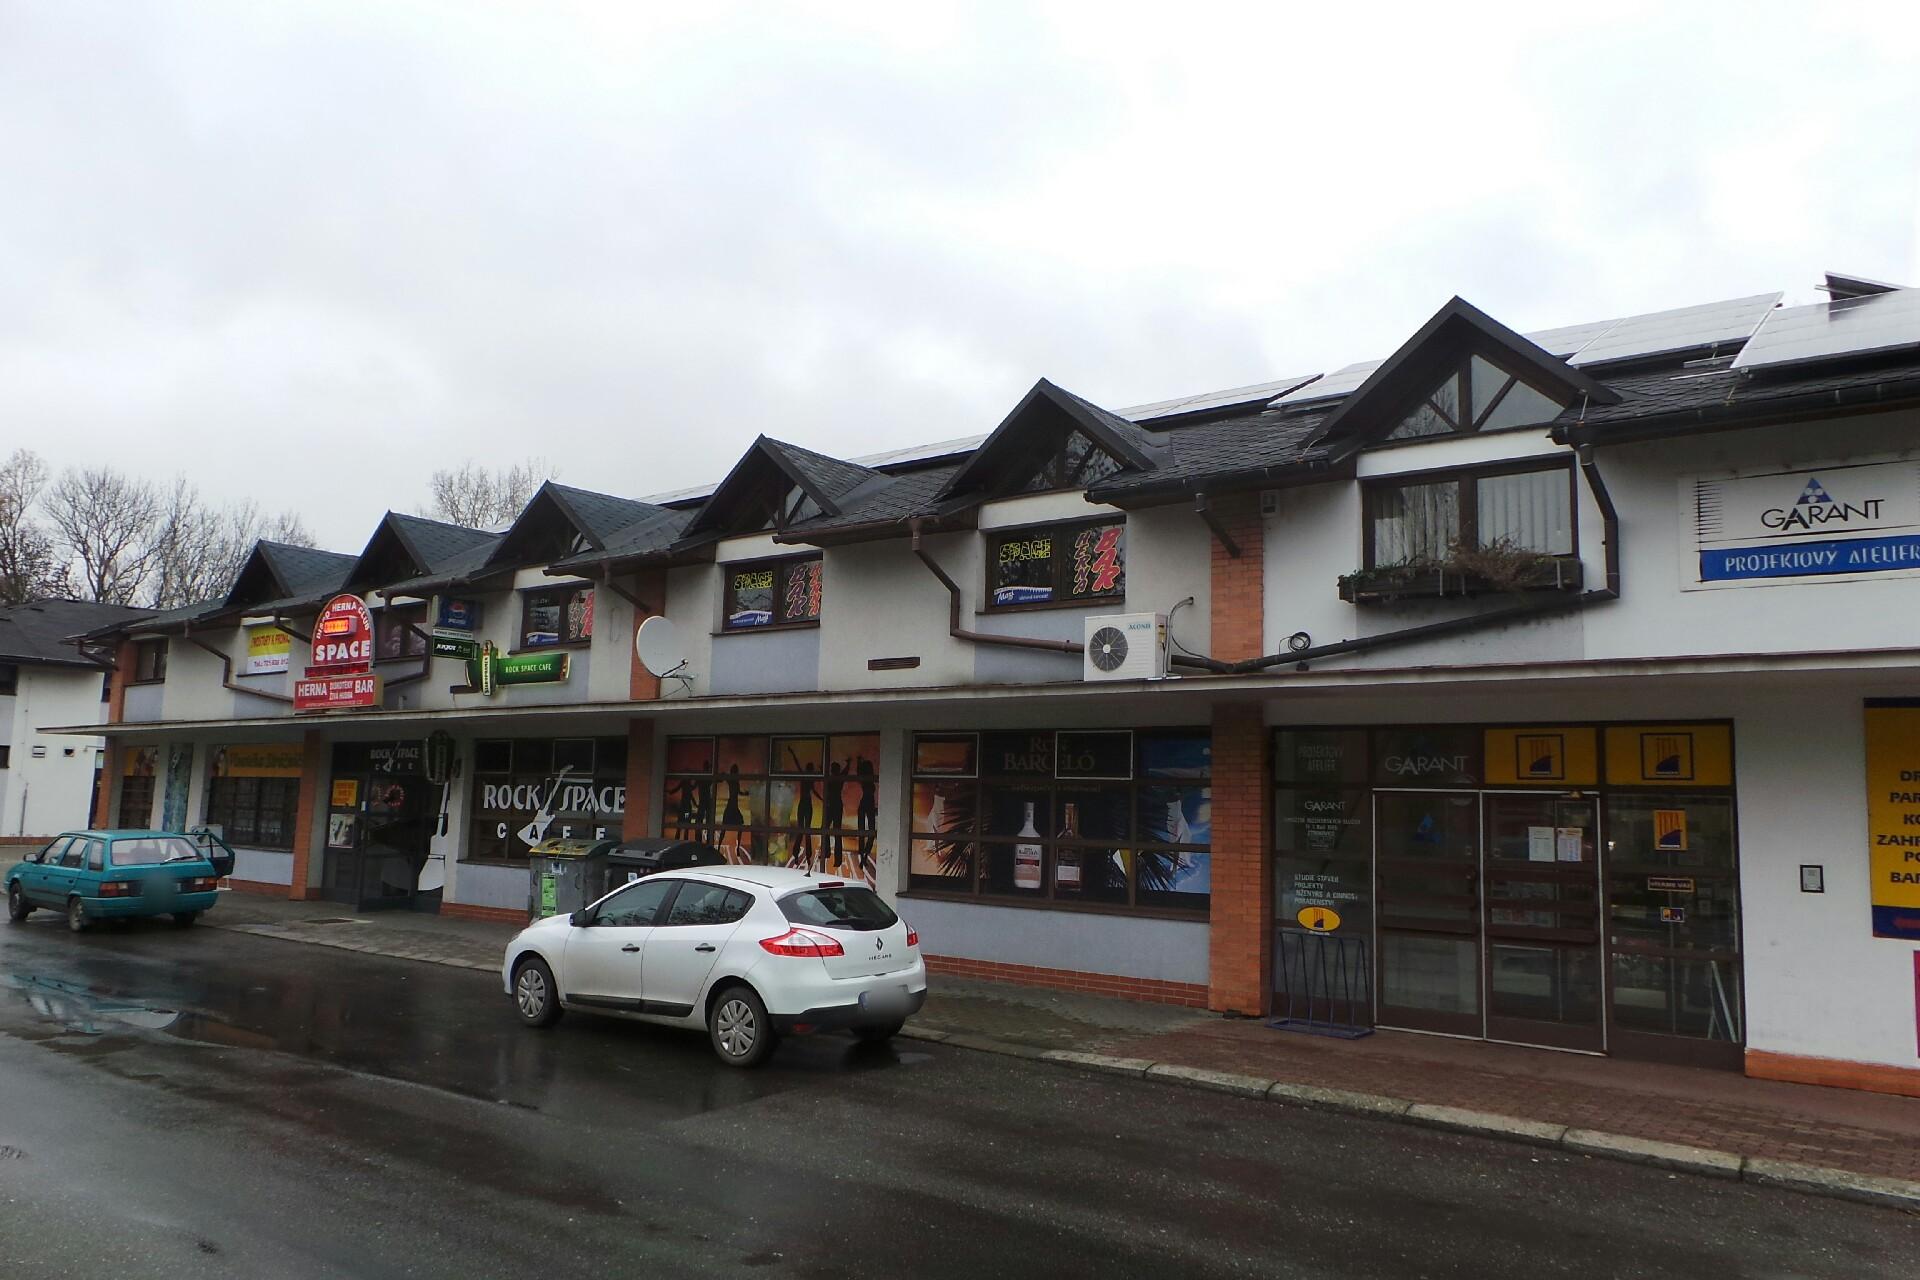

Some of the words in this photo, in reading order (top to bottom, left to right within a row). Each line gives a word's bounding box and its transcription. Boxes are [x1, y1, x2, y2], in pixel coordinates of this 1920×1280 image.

[1761, 498, 1885, 531] GARANT
[999, 539, 1051, 563] SPACE
[1092, 527, 1123, 592] BAR
[332, 601, 357, 613] HERNA
[314, 639, 371, 662] SPACE
[298, 682, 328, 697] HERNA
[354, 679, 374, 694] BAR
[1384, 755, 1469, 776] GARANT
[483, 784, 541, 811] ROCK
[559, 785, 625, 813] SPACE
[1304, 800, 1346, 812] GARANT
